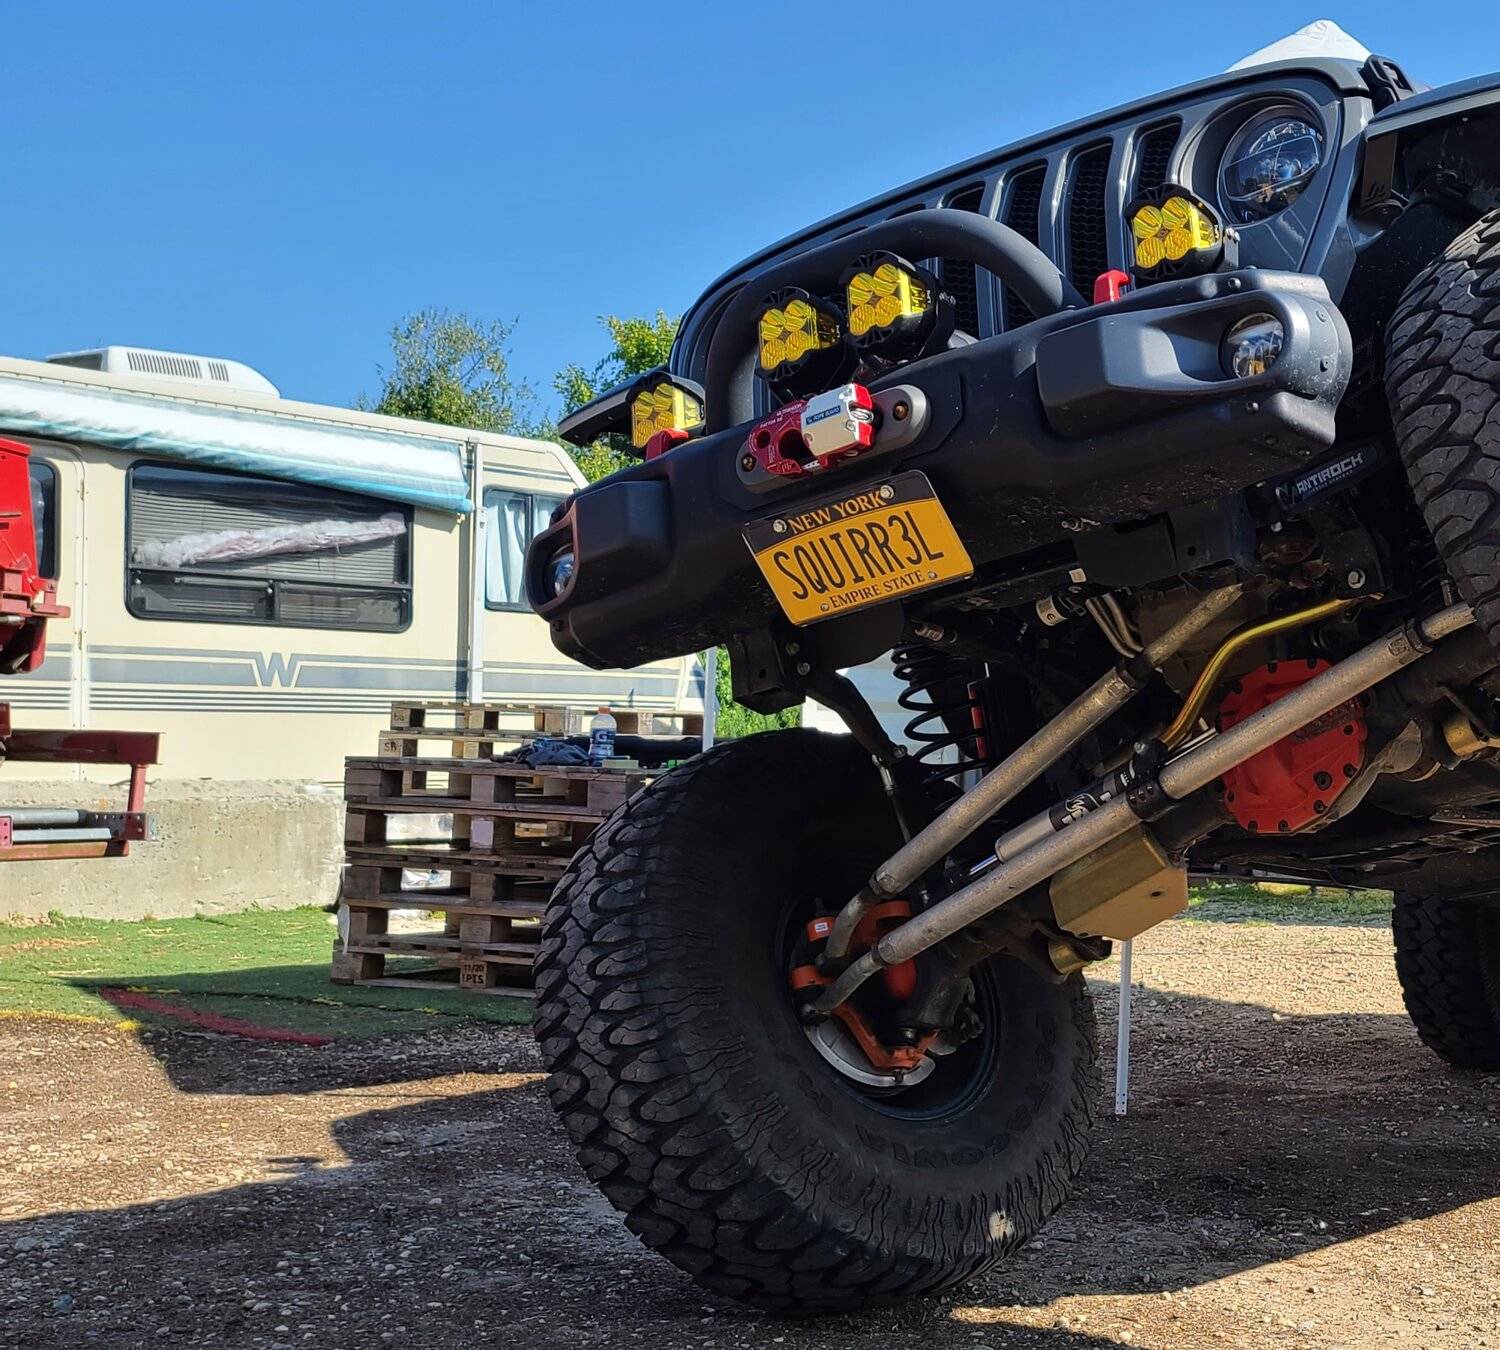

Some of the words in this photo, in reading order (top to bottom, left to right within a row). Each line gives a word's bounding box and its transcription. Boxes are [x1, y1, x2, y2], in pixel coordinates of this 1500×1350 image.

[1297, 452, 1364, 494] ANTIROCK
[787, 507, 832, 534] NEW
[833, 490, 887, 518] YORK
[773, 510, 945, 600] SQUIRR3L
[829, 584, 882, 609] EMPIRE
[885, 570, 926, 592] STATE
[255, 652, 299, 687] W
